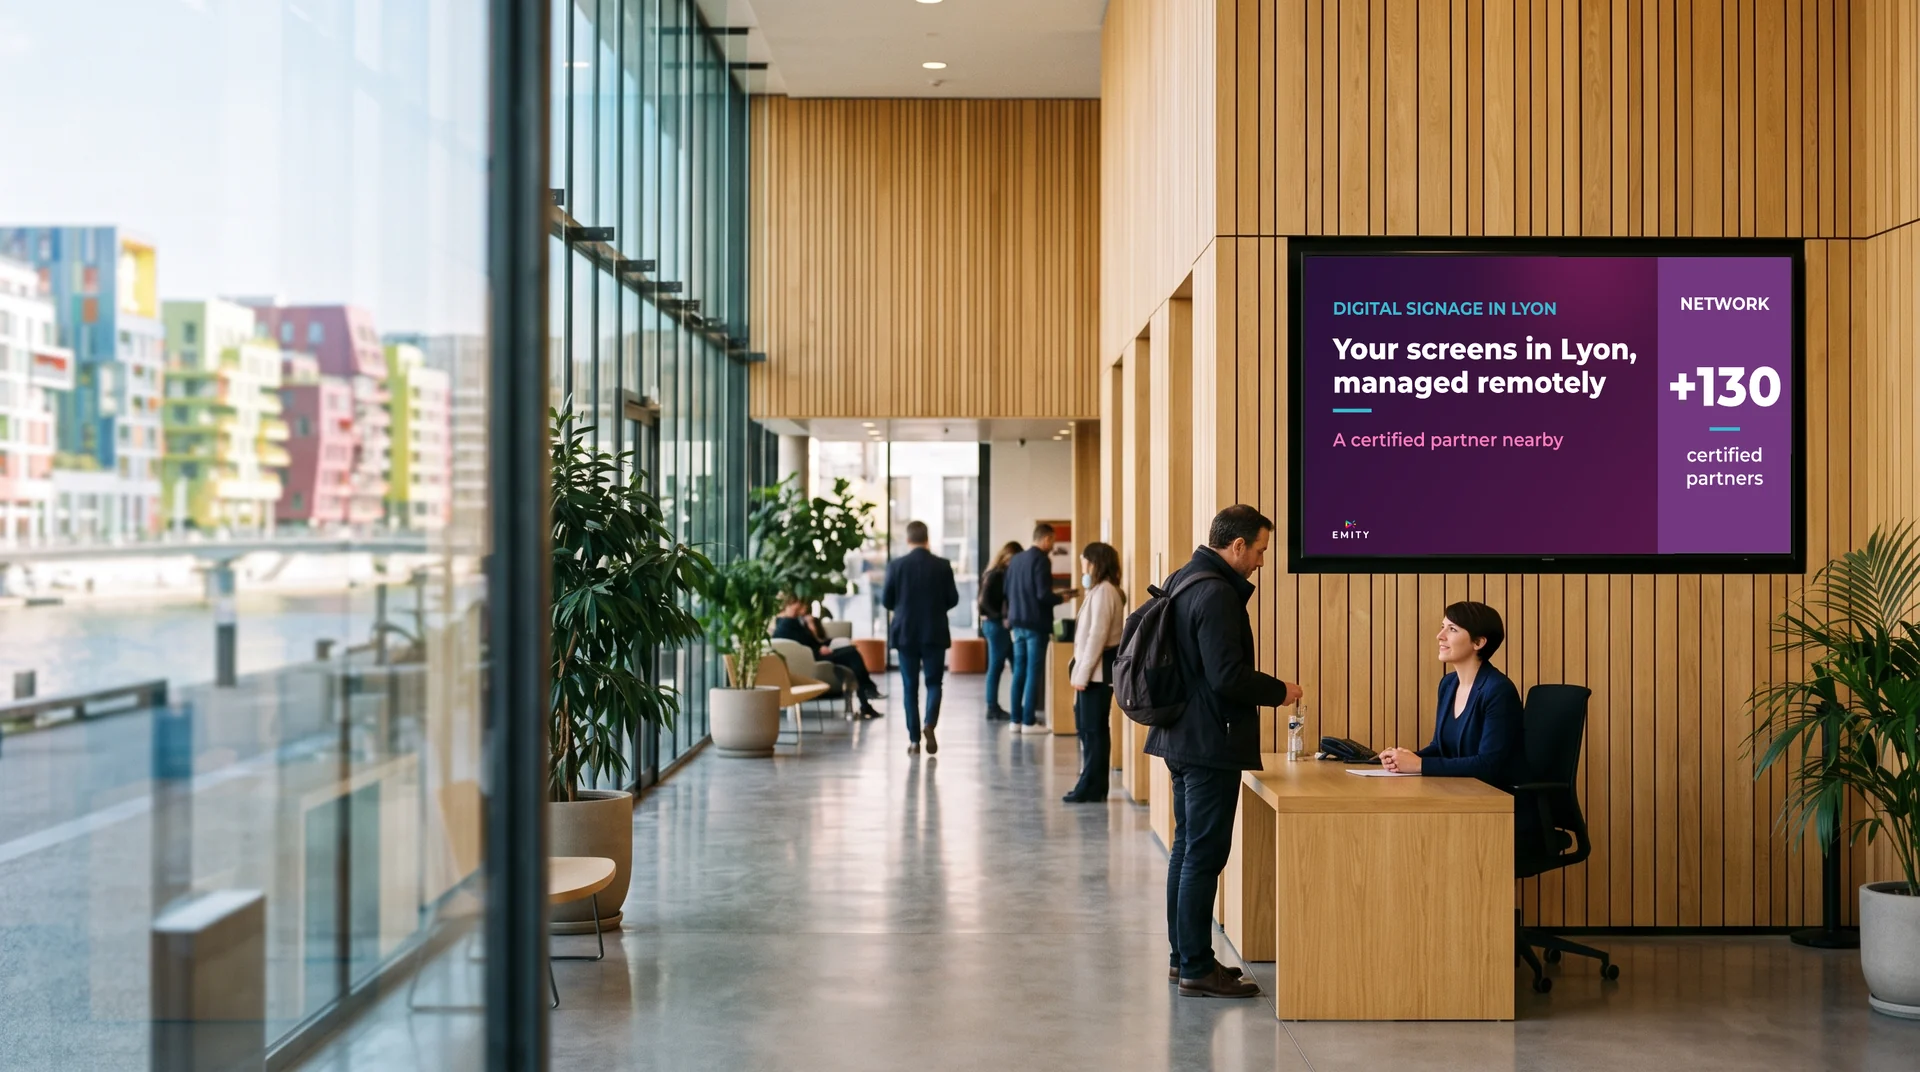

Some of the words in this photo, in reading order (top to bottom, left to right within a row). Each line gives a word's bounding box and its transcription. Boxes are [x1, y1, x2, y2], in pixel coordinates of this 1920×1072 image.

[1333, 301, 1402, 316] DIGITAL
[1406, 301, 1483, 316] SIGNAGE
[1488, 301, 1506, 316] IN
[1511, 301, 1557, 316] LYON
[1680, 296, 1770, 311] NETWORK
[1332, 337, 1399, 361] Your
[1406, 342, 1517, 361] screens
[1526, 336, 1552, 361] in
[1562, 337, 1637, 366] Lyon,
[1333, 370, 1469, 400] managed
[1478, 370, 1607, 400] remotely
[1669, 365, 1782, 408] +130
[1332, 432, 1347, 448] A
[1350, 431, 1425, 448] certified
[1430, 433, 1498, 451] partner
[1502, 431, 1565, 451] nearby
[1686, 446, 1763, 463] certified
[1686, 471, 1764, 489] partners
[1332, 530, 1370, 540] EMITY
